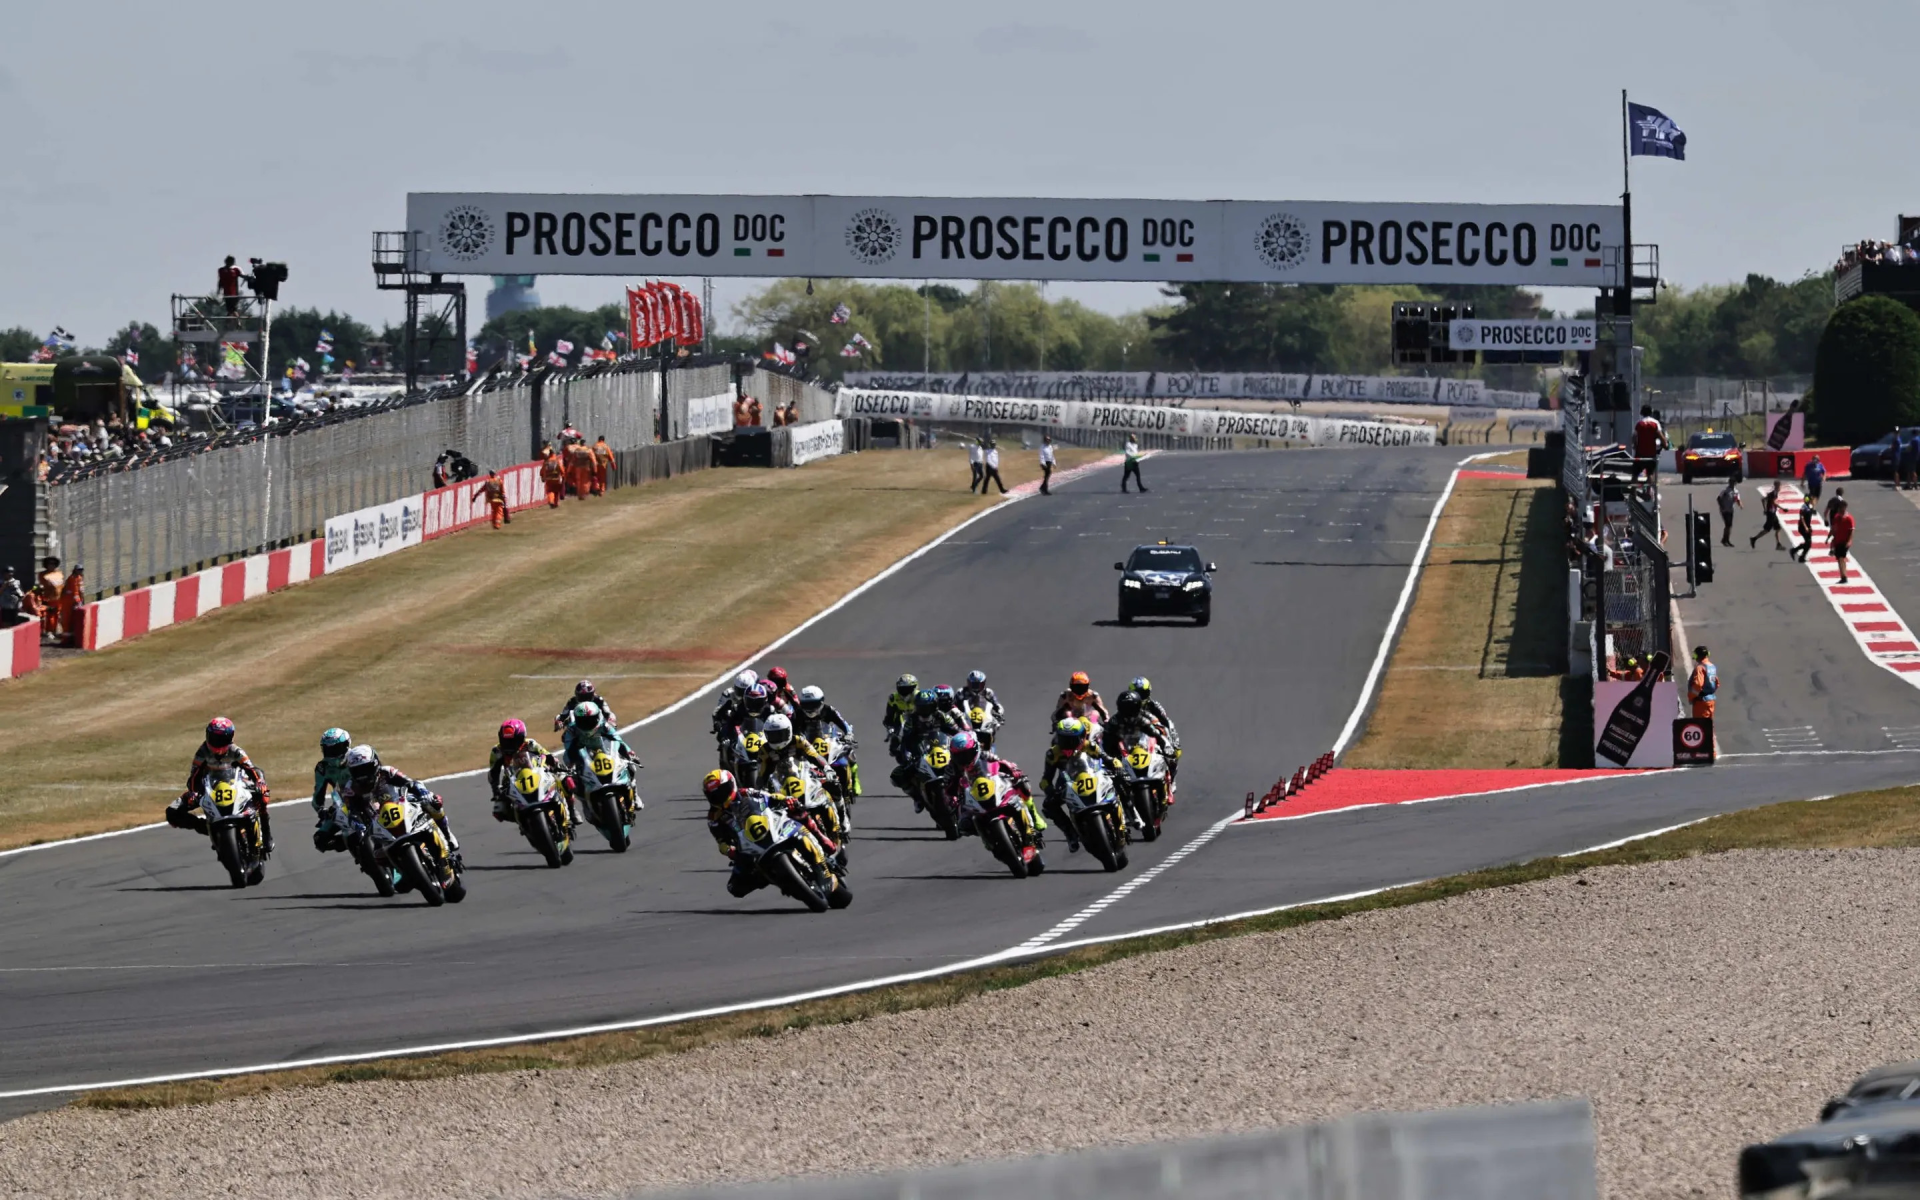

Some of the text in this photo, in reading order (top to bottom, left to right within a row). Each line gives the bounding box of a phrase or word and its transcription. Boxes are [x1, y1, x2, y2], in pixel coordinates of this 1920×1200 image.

[506, 211, 785, 257] PROSECCO DOC
[913, 215, 1195, 262] PROSECCO DOC
[1322, 220, 1601, 267] PROSECCO DOC
[1481, 326, 1592, 344] PROSECCO DOC
[851, 395, 910, 414] OSECCO
[964, 400, 1038, 420] PROSECCO
[1092, 407, 1166, 430] PROSECCO
[1216, 417, 1288, 437] PROSECCO
[746, 737, 761, 748] 64
[1684, 731, 1701, 741] 60
[929, 752, 947, 765] 15
[1132, 753, 1148, 766] 37
[519, 776, 534, 791] 11
[977, 782, 989, 797] 8
[1077, 778, 1094, 795] 20
[215, 789, 233, 803] 83
[381, 807, 401, 827] 36
[751, 821, 766, 841] 6
